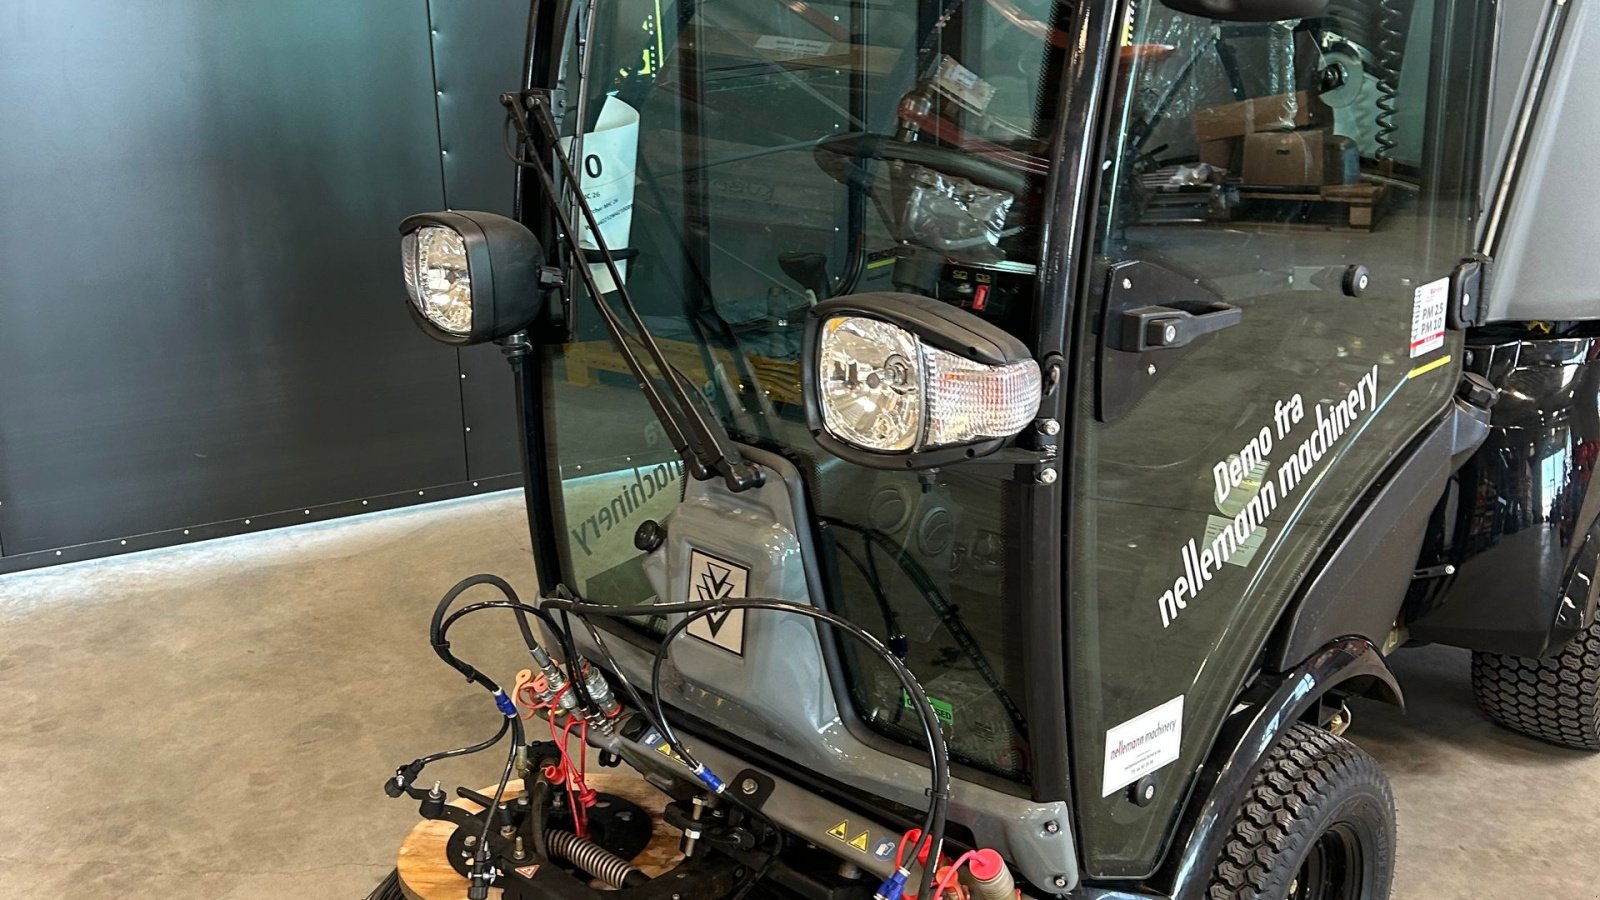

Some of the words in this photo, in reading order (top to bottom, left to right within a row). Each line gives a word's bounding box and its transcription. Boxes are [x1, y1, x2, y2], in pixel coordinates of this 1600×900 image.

[1421, 320, 1433, 335] PM
[1433, 317, 1443, 331] 10
[1422, 306, 1434, 320] PM
[1213, 426, 1273, 504] Demo
[1274, 393, 1304, 440] fra
[1158, 480, 1277, 628] nellemann
[1278, 364, 1378, 498] machinery
[1111, 736, 1144, 760] nellemann
[1145, 719, 1177, 743] machinery
